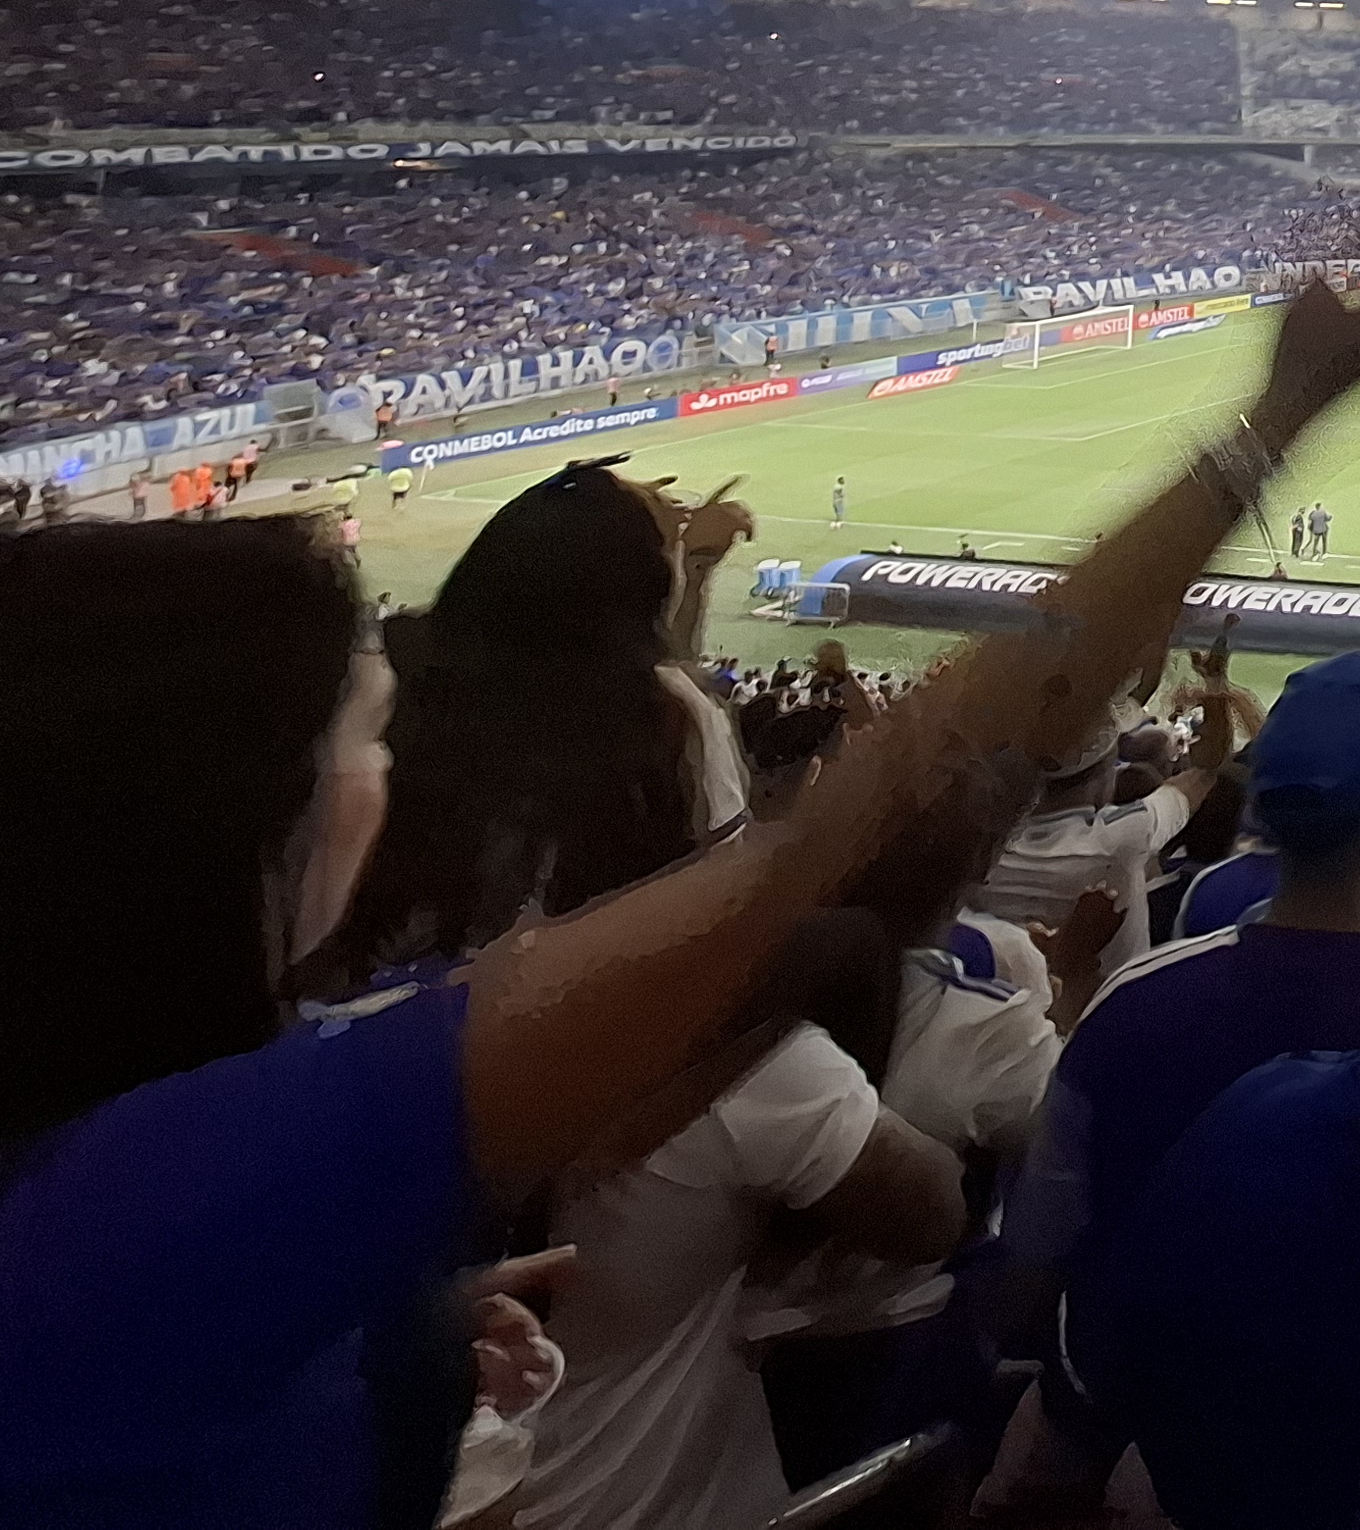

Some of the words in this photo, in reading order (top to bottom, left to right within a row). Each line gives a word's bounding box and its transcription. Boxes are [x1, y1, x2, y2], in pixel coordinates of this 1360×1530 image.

[406, 139, 589, 156] JAMAIS
[603, 135, 797, 152] VENCIDO
[1085, 317, 1130, 338] AMSTEL
[1150, 306, 1191, 326] AMSTEL
[937, 335, 1031, 367] sportingbet
[719, 381, 789, 404] mapfre
[891, 368, 953, 393] AMSTEL
[410, 431, 518, 463] CONMEBOL
[520, 414, 594, 443] Acredite
[861, 561, 1066, 595] POWERAD
